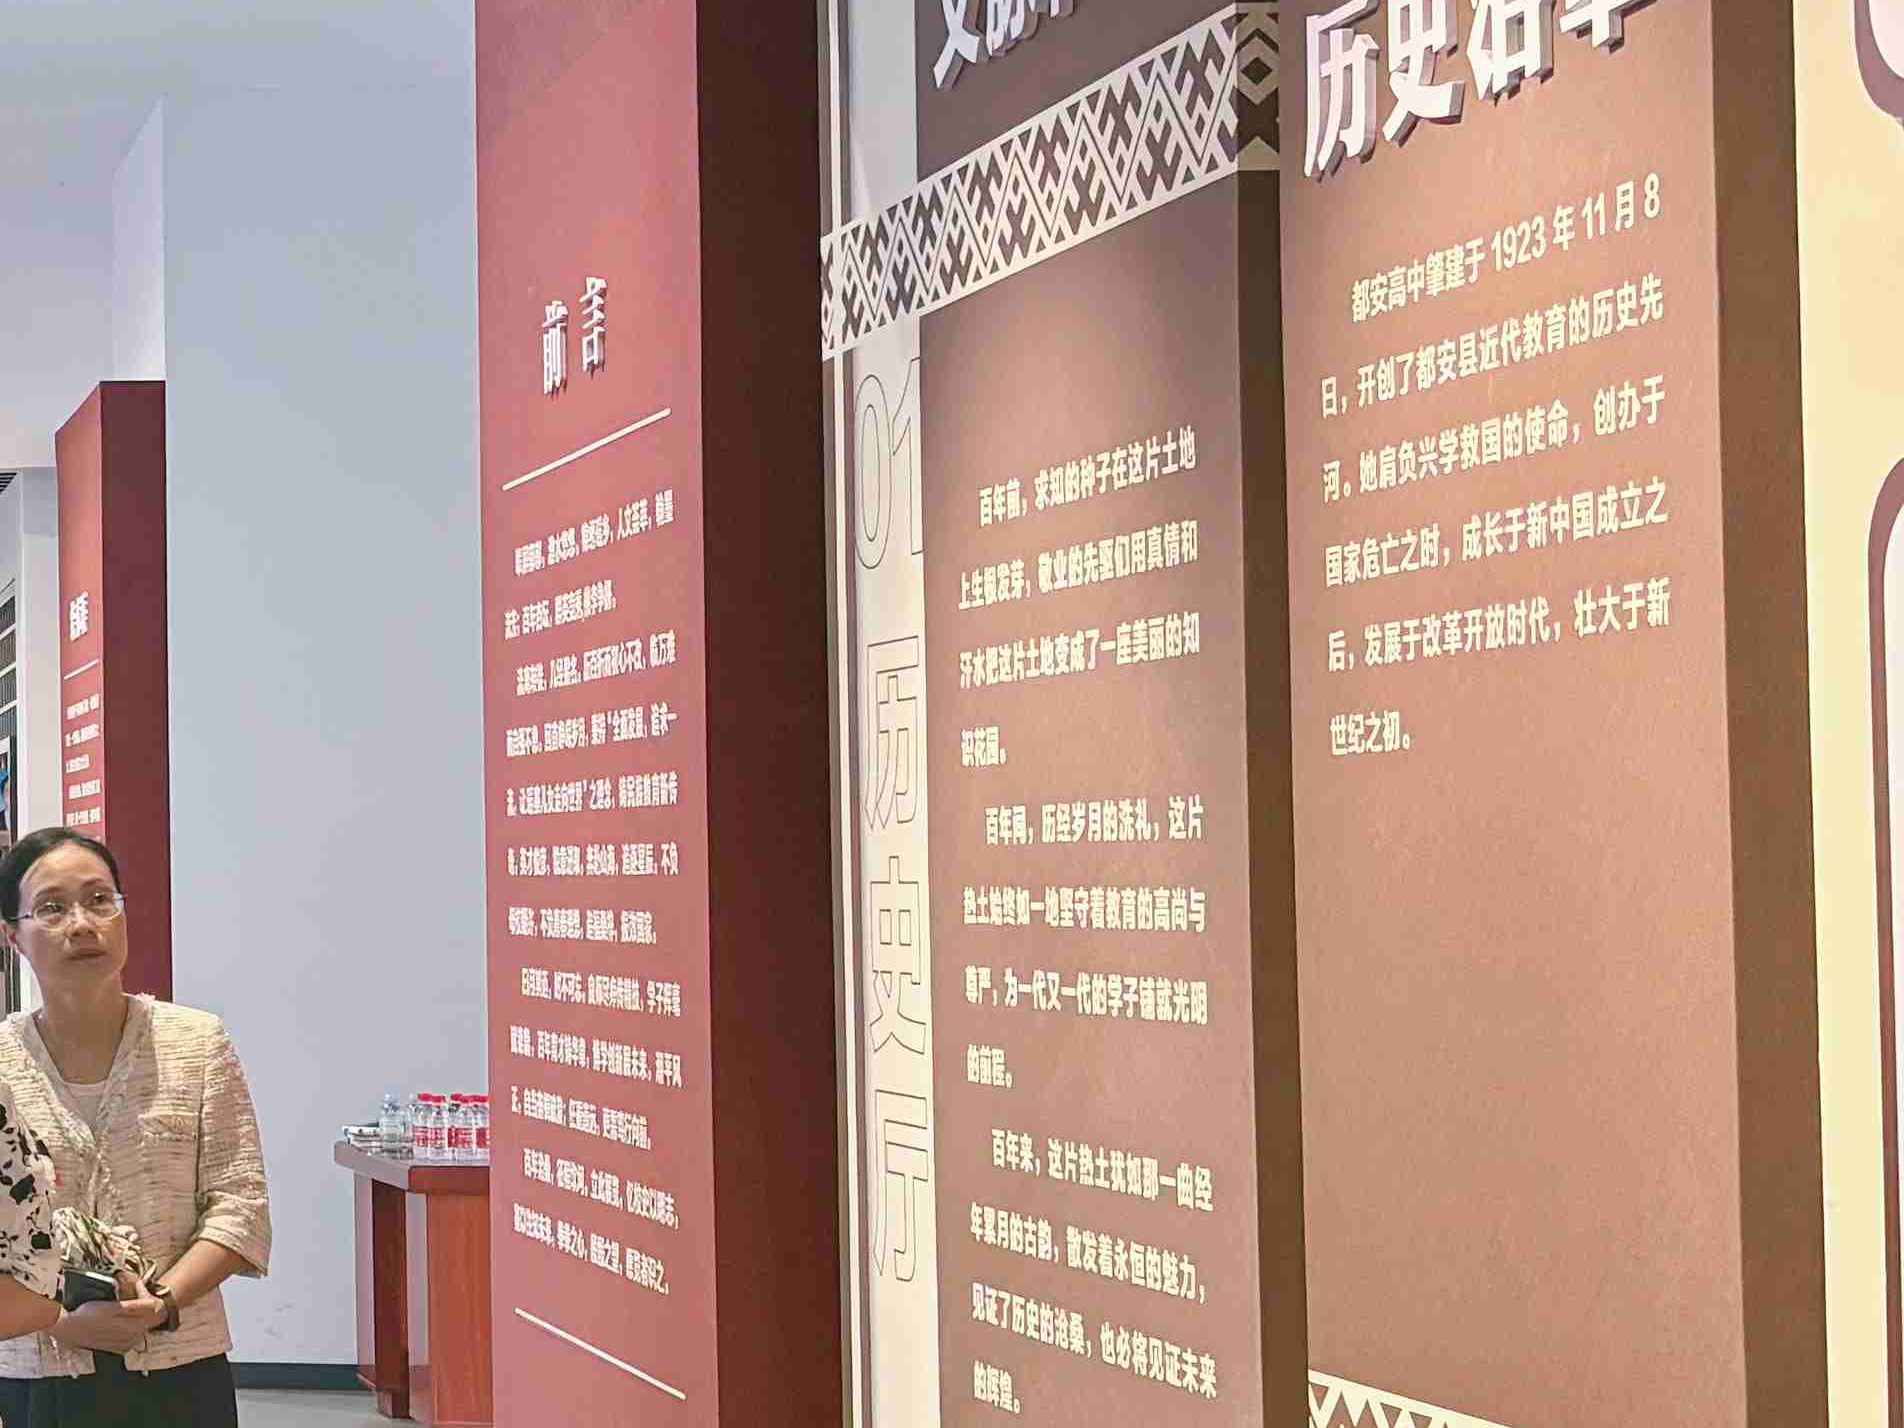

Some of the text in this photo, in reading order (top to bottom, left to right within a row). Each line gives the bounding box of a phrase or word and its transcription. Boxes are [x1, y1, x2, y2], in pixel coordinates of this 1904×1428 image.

[1352, 172, 1660, 323] 都安高中肇建于 1923 年 11 月 8
[542, 278, 607, 394] 前言
[1320, 274, 1663, 418] 日，开创了都安县近代教育的历史先
[1323, 375, 1665, 503] 河。她肩负兴学救国的使命，创办于
[1325, 475, 1668, 588] 国家危亡之时，成长于新中国成立之
[1328, 577, 1670, 673] 后，发展于改革开放时代，壮大于新
[1330, 710, 1411, 756] 世纪之初。
[865, 636, 929, 1283] 历史厅
